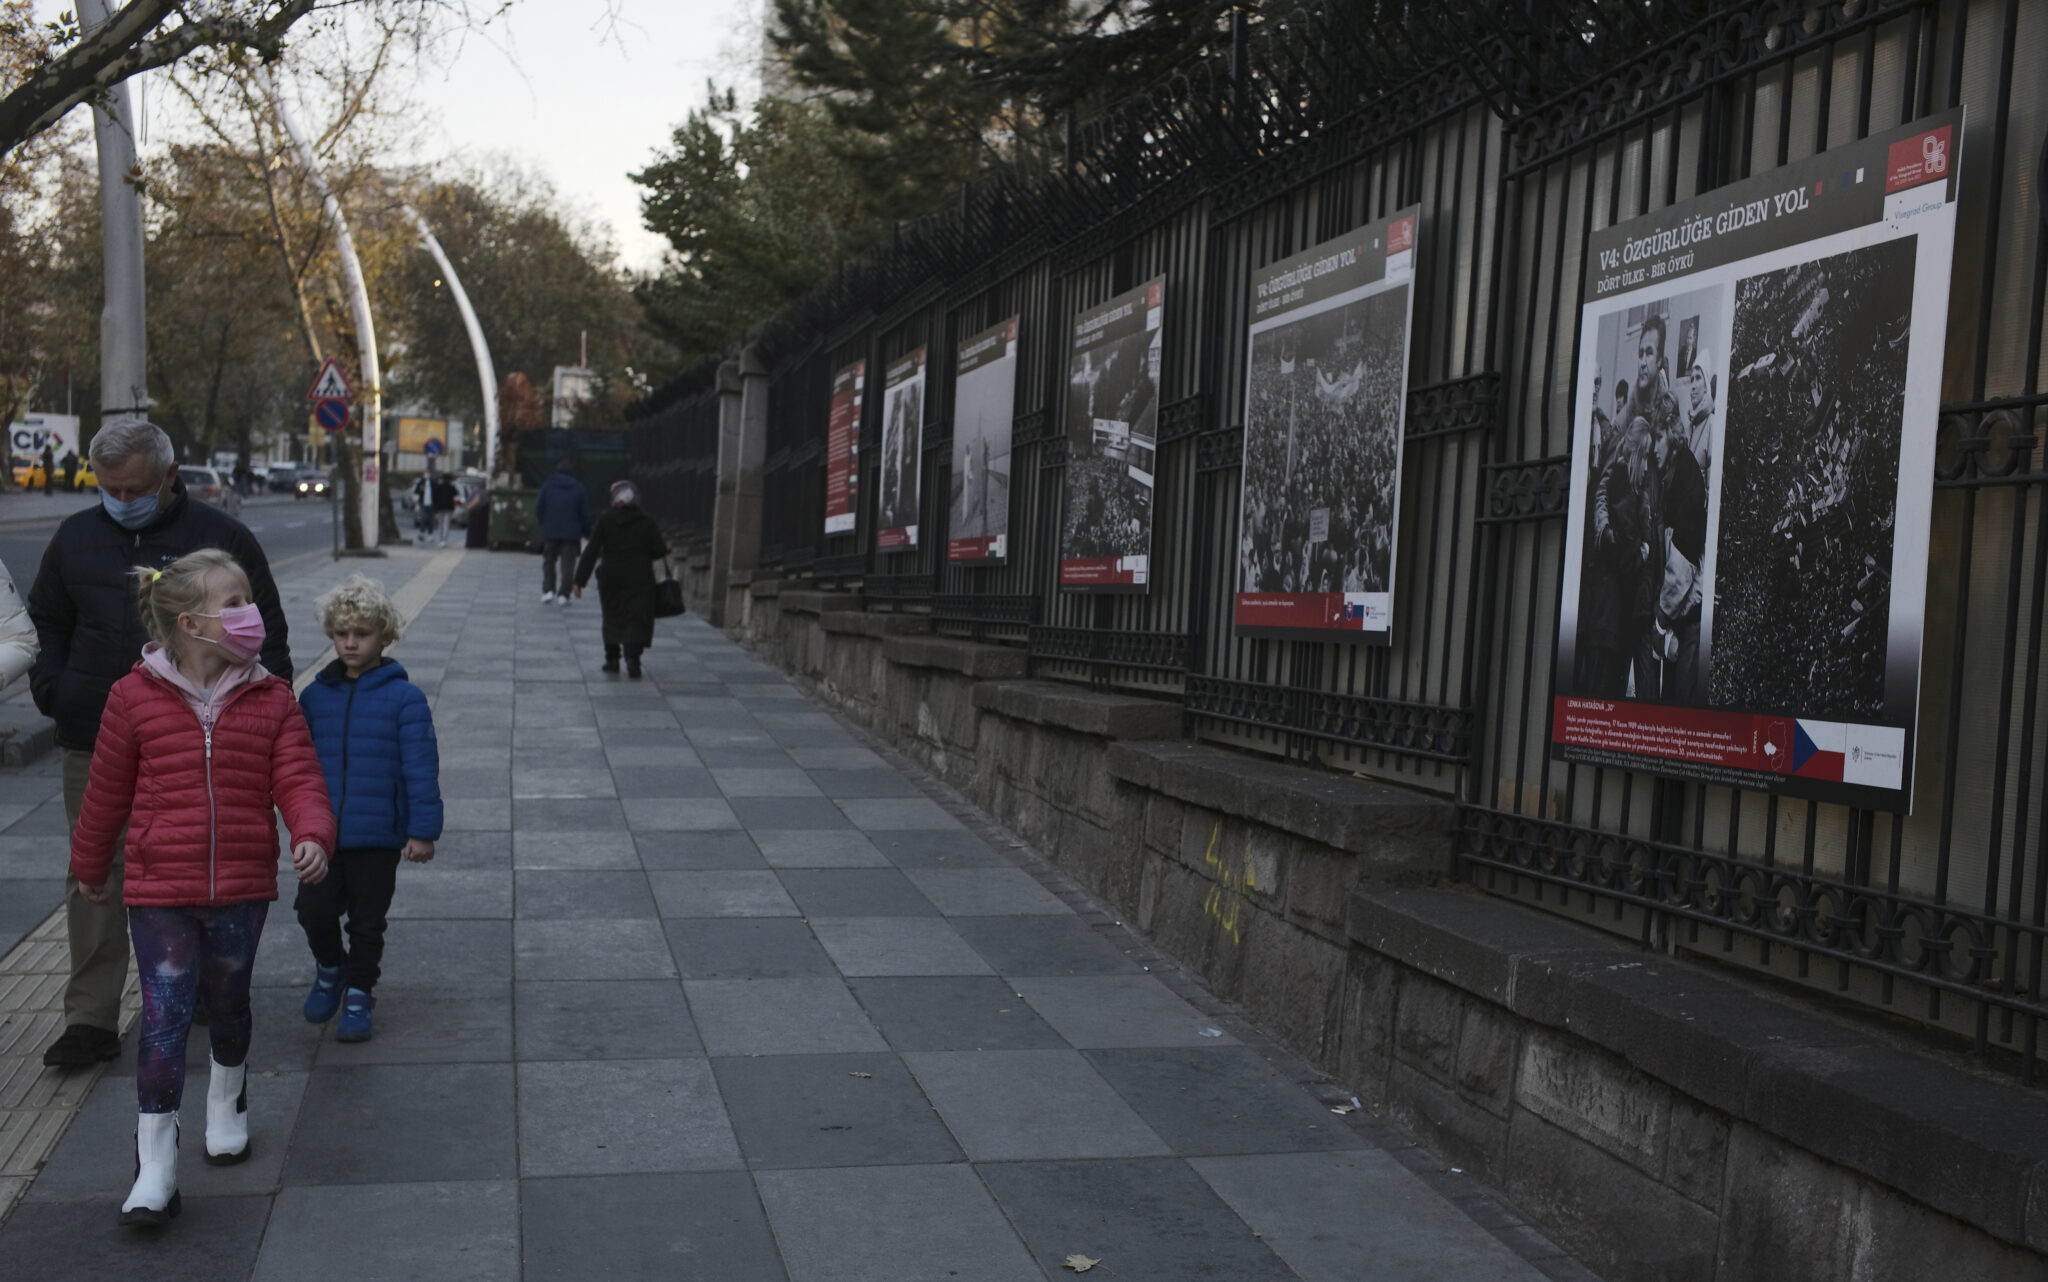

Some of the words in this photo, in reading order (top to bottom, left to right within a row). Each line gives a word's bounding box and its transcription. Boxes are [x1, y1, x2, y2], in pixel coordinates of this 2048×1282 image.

[1922, 201, 1942, 213] Group
[1600, 249, 1620, 270] V4:
[1623, 214, 1713, 264] ÖZGÜRLÜĞE
[1716, 203, 1770, 235] GİDEN
[1774, 187, 1809, 217] YOL
[1597, 276, 1620, 294] DÖRT
[1622, 268, 1645, 286] ÜLKE
[1651, 260, 1666, 278] BİR
[1668, 250, 1694, 272] ÖYKÜ
[1568, 699, 1581, 708] LENKA
